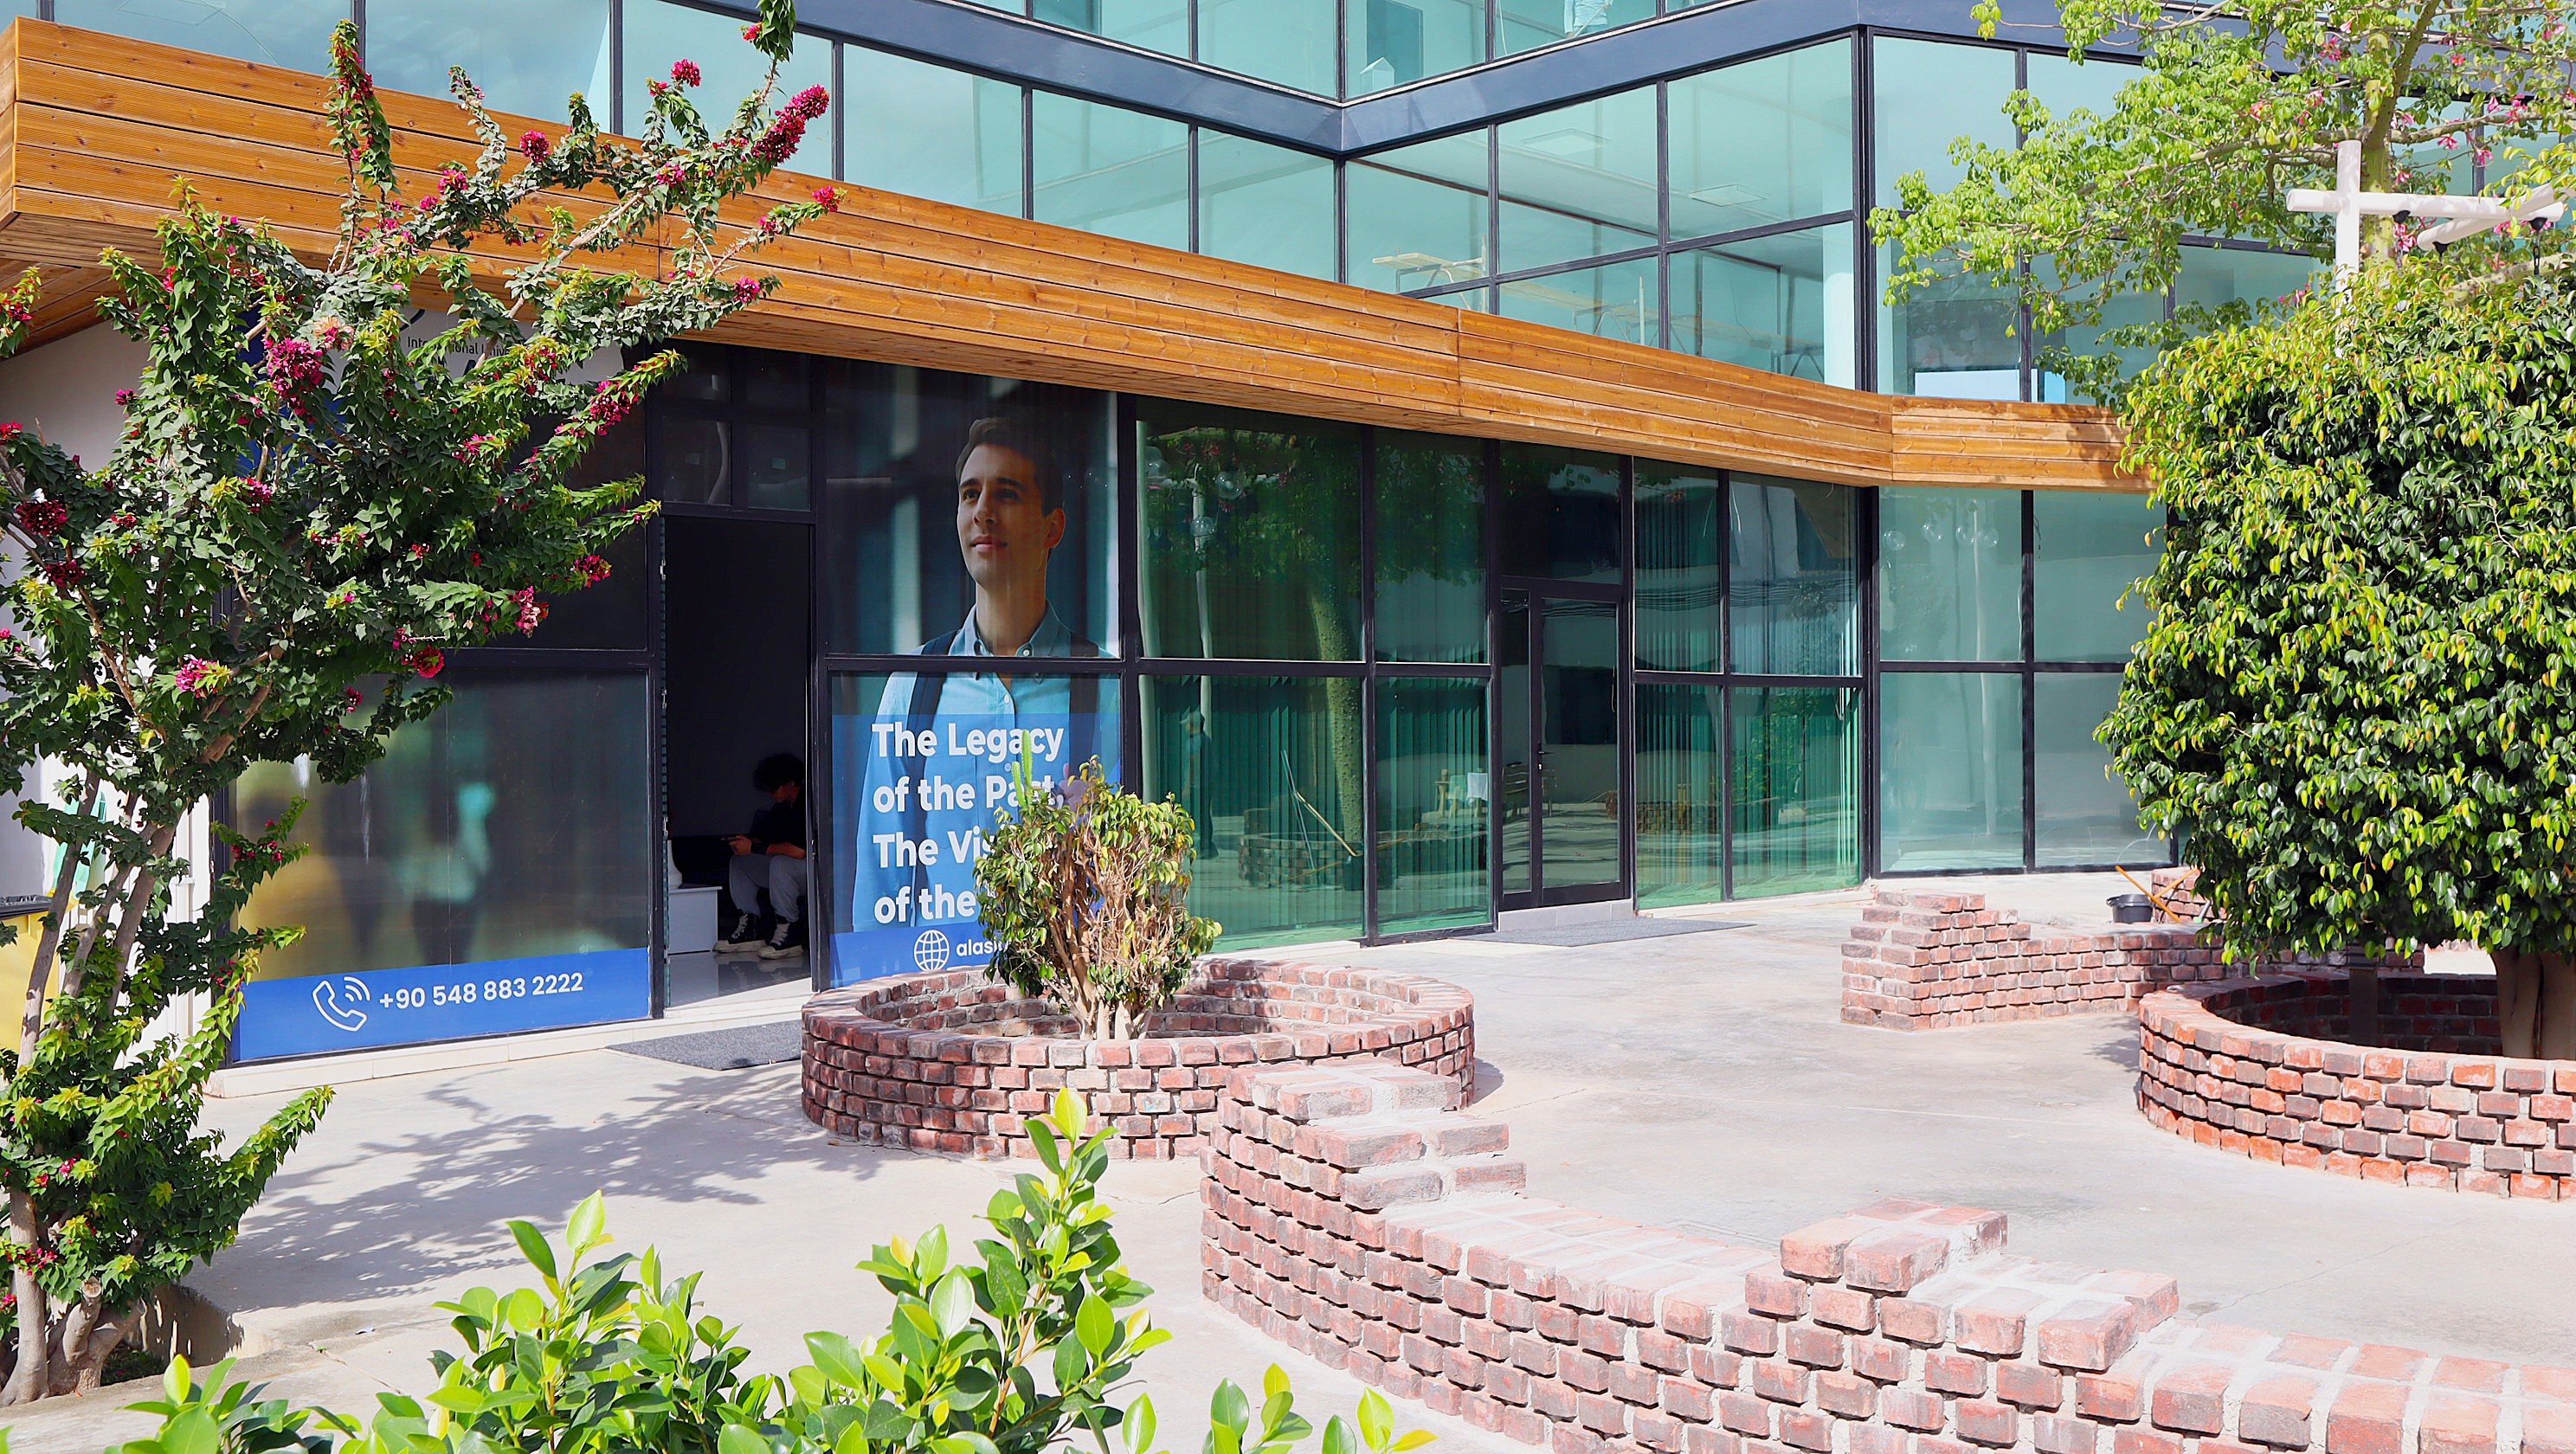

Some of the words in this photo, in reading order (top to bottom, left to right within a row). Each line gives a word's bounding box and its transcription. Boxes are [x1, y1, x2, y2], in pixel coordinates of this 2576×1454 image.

[872, 721, 937, 757] The
[949, 723, 1064, 763] Legacy
[873, 775, 910, 813] of
[918, 775, 976, 811] the
[873, 831, 939, 868] The
[947, 825, 996, 864] Vis
[874, 886, 911, 924] of
[919, 884, 976, 921] the
[379, 987, 426, 1009] +90
[433, 982, 477, 1007] 548
[483, 977, 526, 1001] 883
[531, 972, 583, 996] 2222
